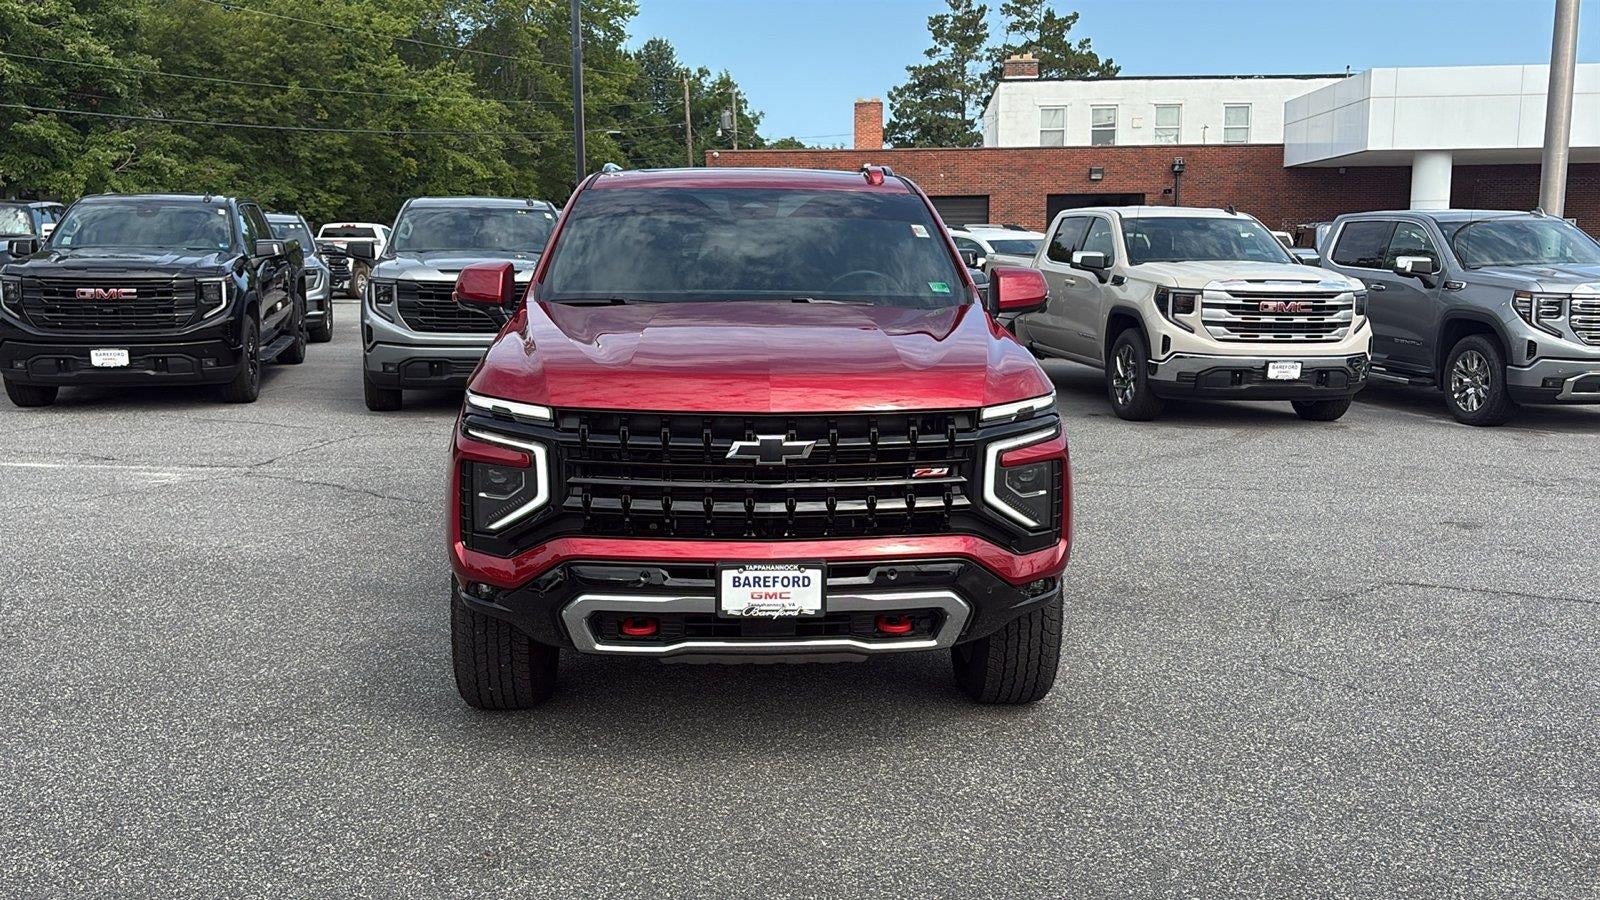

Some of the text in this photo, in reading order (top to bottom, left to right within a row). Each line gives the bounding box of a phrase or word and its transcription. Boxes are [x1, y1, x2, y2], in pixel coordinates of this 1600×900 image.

[75, 288, 138, 300] GMC
[1259, 301, 1313, 313] GMC
[732, 576, 811, 588] BAREFORD
[750, 591, 792, 600] GMC
